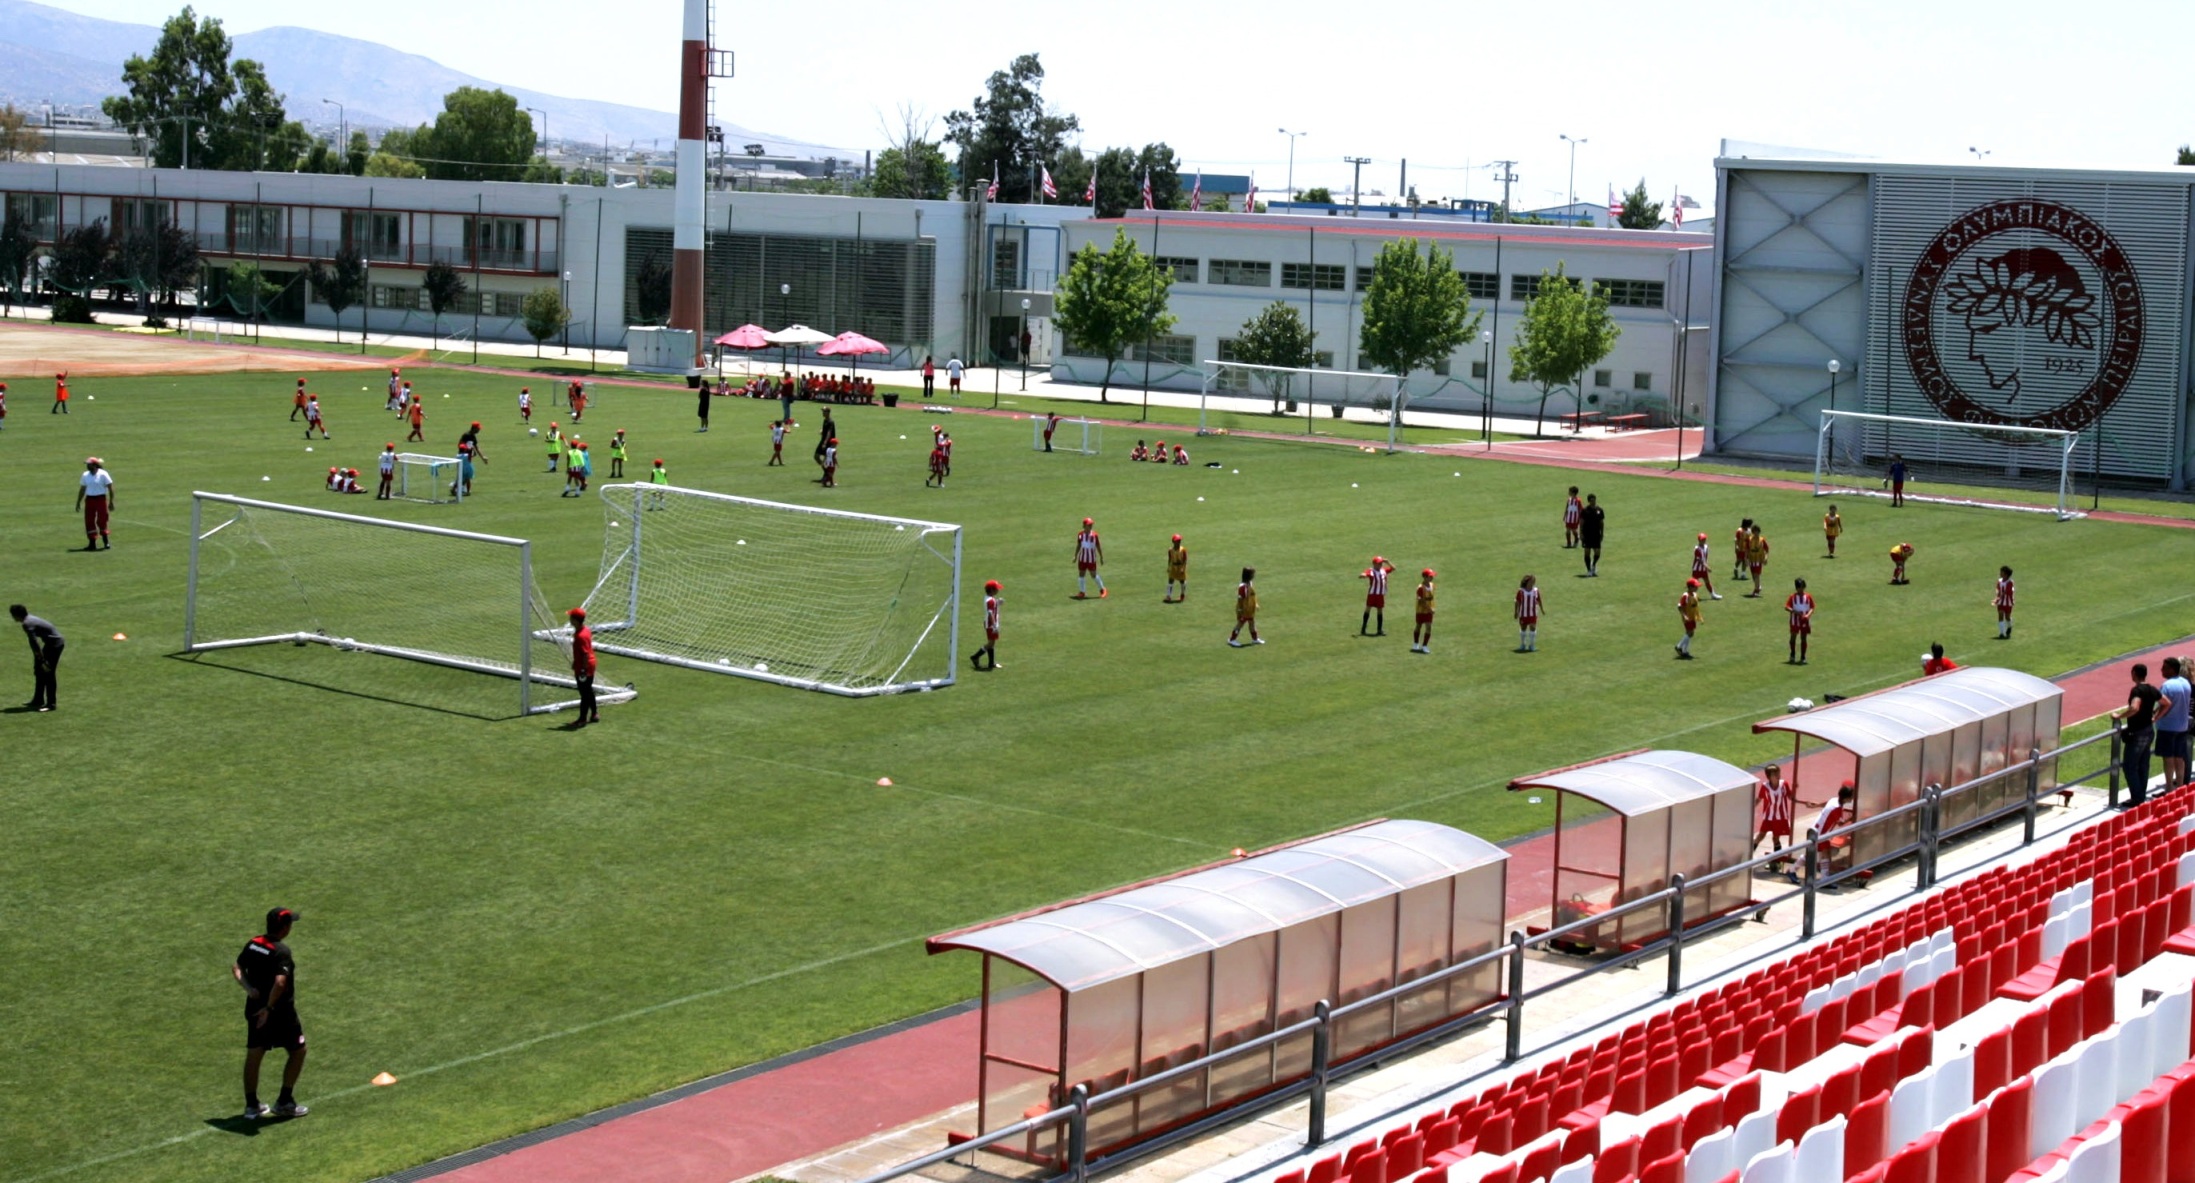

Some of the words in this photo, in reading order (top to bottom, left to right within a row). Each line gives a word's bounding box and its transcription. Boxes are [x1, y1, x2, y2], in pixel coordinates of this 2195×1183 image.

[1942, 203, 2112, 258] ΟΛΥΜΠΙΑΚΟΣ
[1908, 256, 1960, 410] ΣΥΝΔΕΣΜΟΣ
[2102, 263, 2138, 389] ΠΕΙΡΑΙΩΣ
[2045, 357, 2084, 375] 1925
